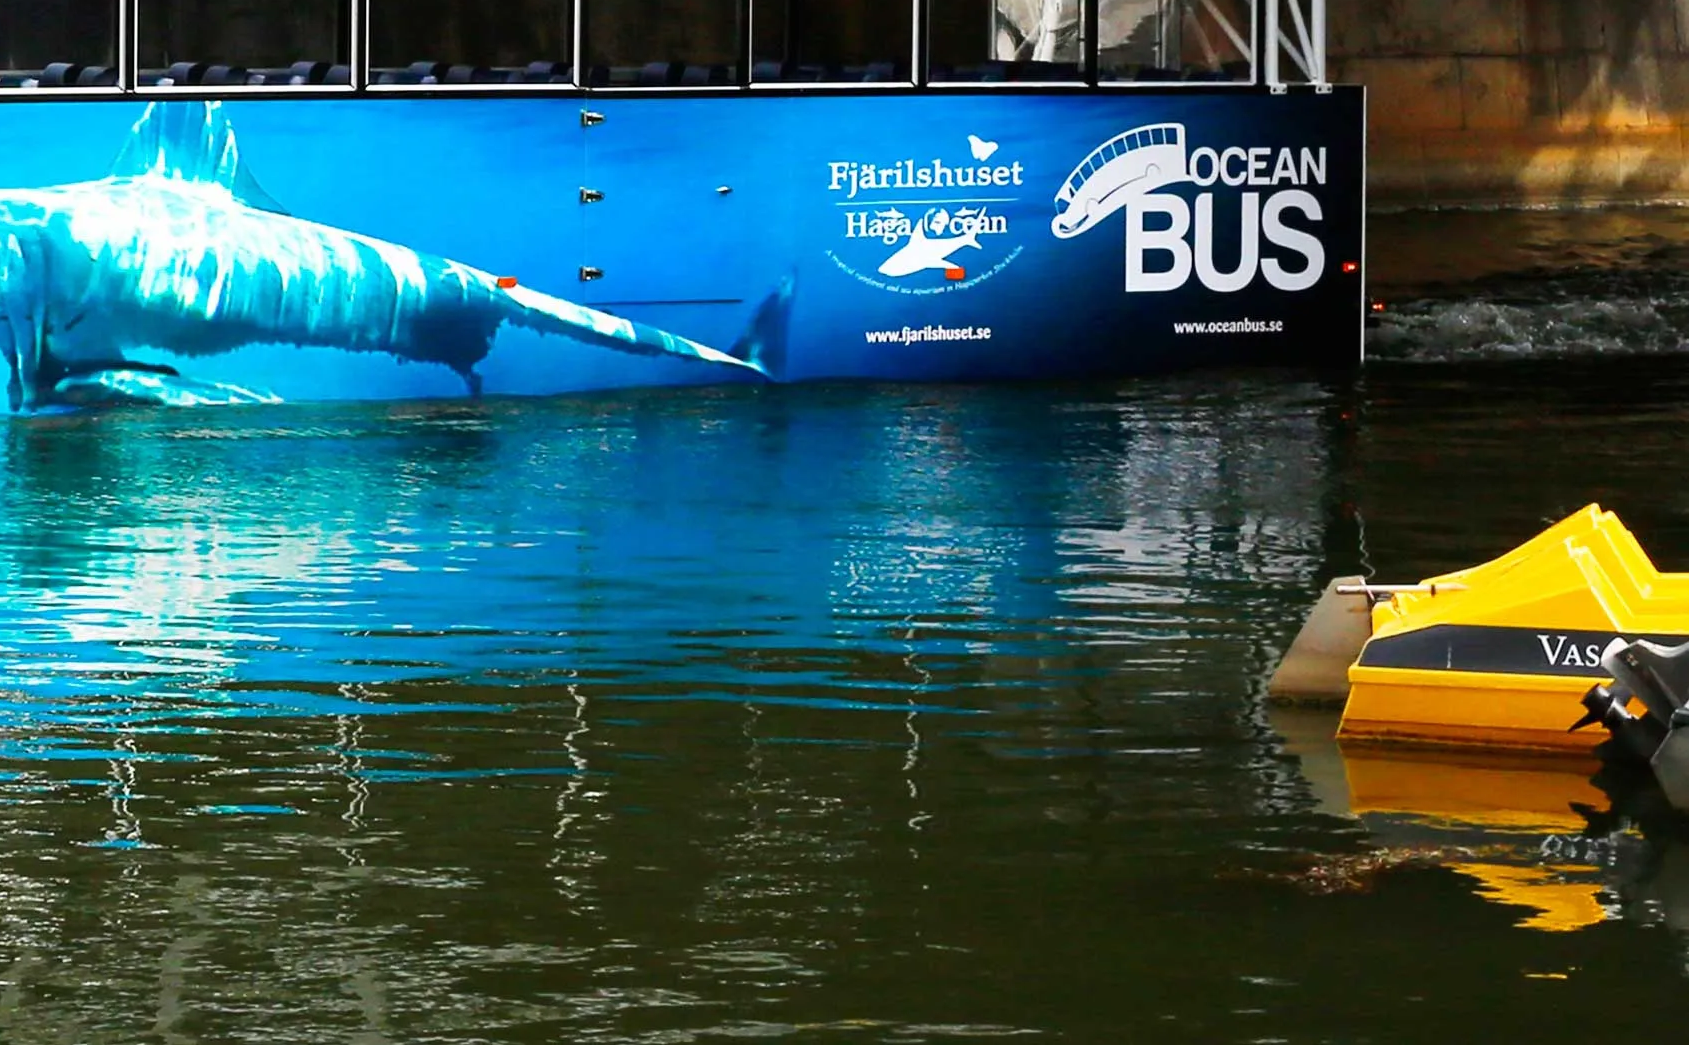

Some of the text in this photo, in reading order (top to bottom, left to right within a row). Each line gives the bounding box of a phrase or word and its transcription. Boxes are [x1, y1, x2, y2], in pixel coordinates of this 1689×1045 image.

[827, 158, 1024, 199] Fjärilshuset
[1189, 146, 1327, 186] OCEAN
[844, 206, 1008, 245] Haga Ocean
[1125, 189, 1326, 293] BUS
[865, 325, 991, 346] www.fjarilshuset.se
[1173, 317, 1284, 334] www.oceanbus.se
[1537, 634, 1601, 667] VAS
